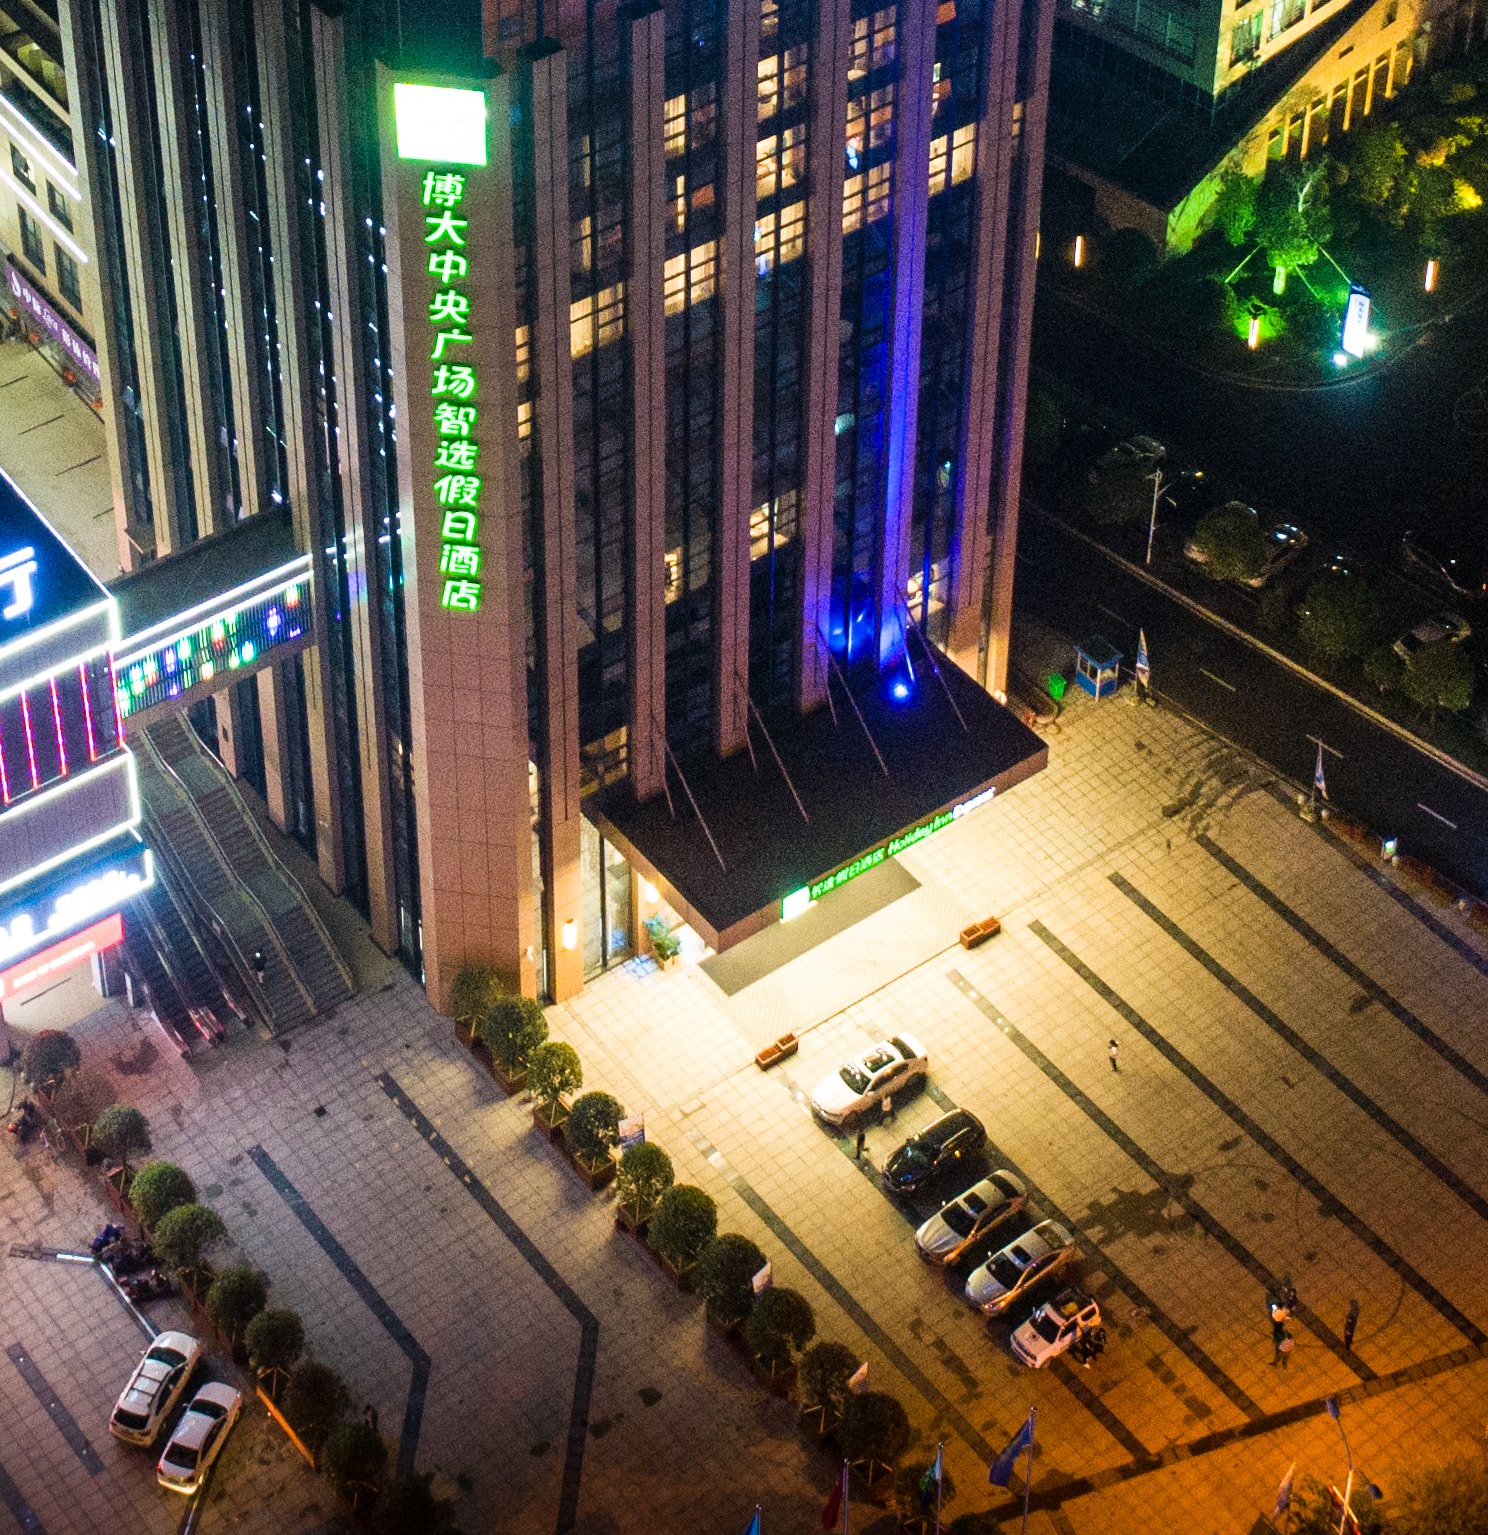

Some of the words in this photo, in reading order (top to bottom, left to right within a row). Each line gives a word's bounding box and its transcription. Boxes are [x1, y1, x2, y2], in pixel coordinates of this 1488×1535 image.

[421, 170, 482, 612] 博大中央广场智选假日酒店
